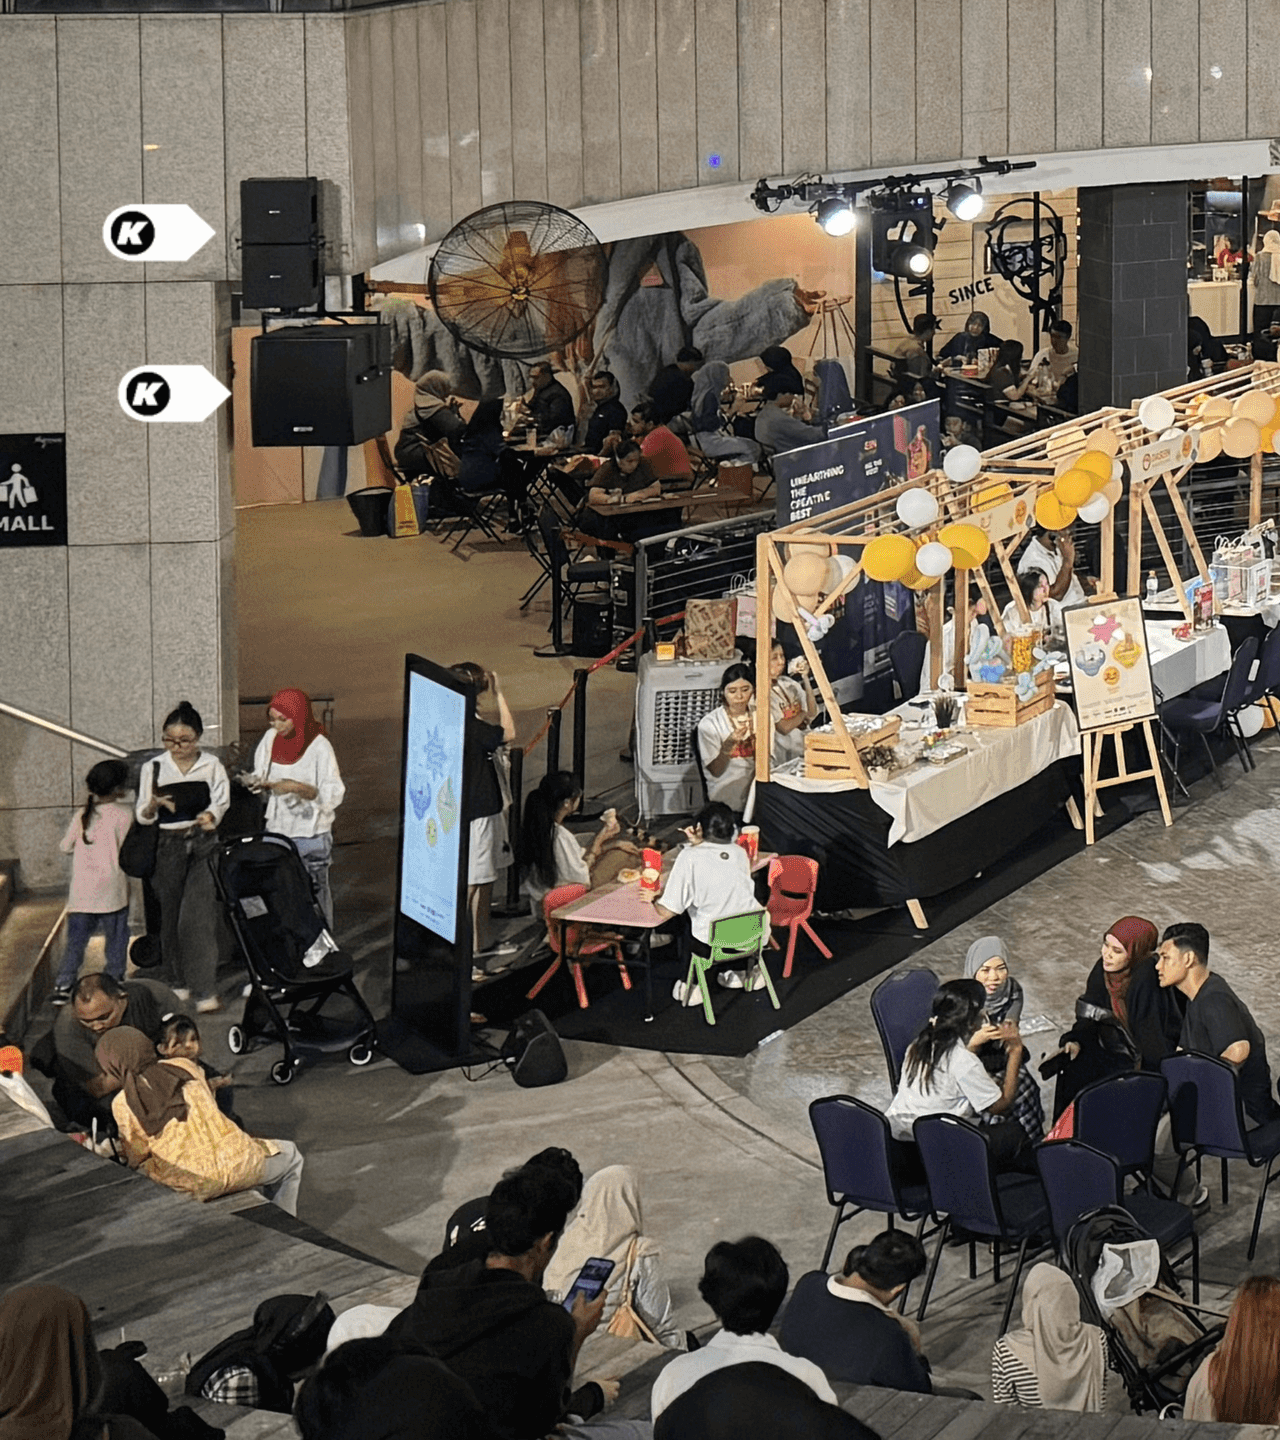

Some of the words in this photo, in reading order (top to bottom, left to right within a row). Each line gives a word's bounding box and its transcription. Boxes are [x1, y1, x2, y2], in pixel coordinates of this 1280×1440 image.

[949, 277, 995, 305] SINCE
[790, 465, 845, 488] UNEARTHING
[790, 486, 807, 499] THE
[790, 508, 813, 522] BEST
